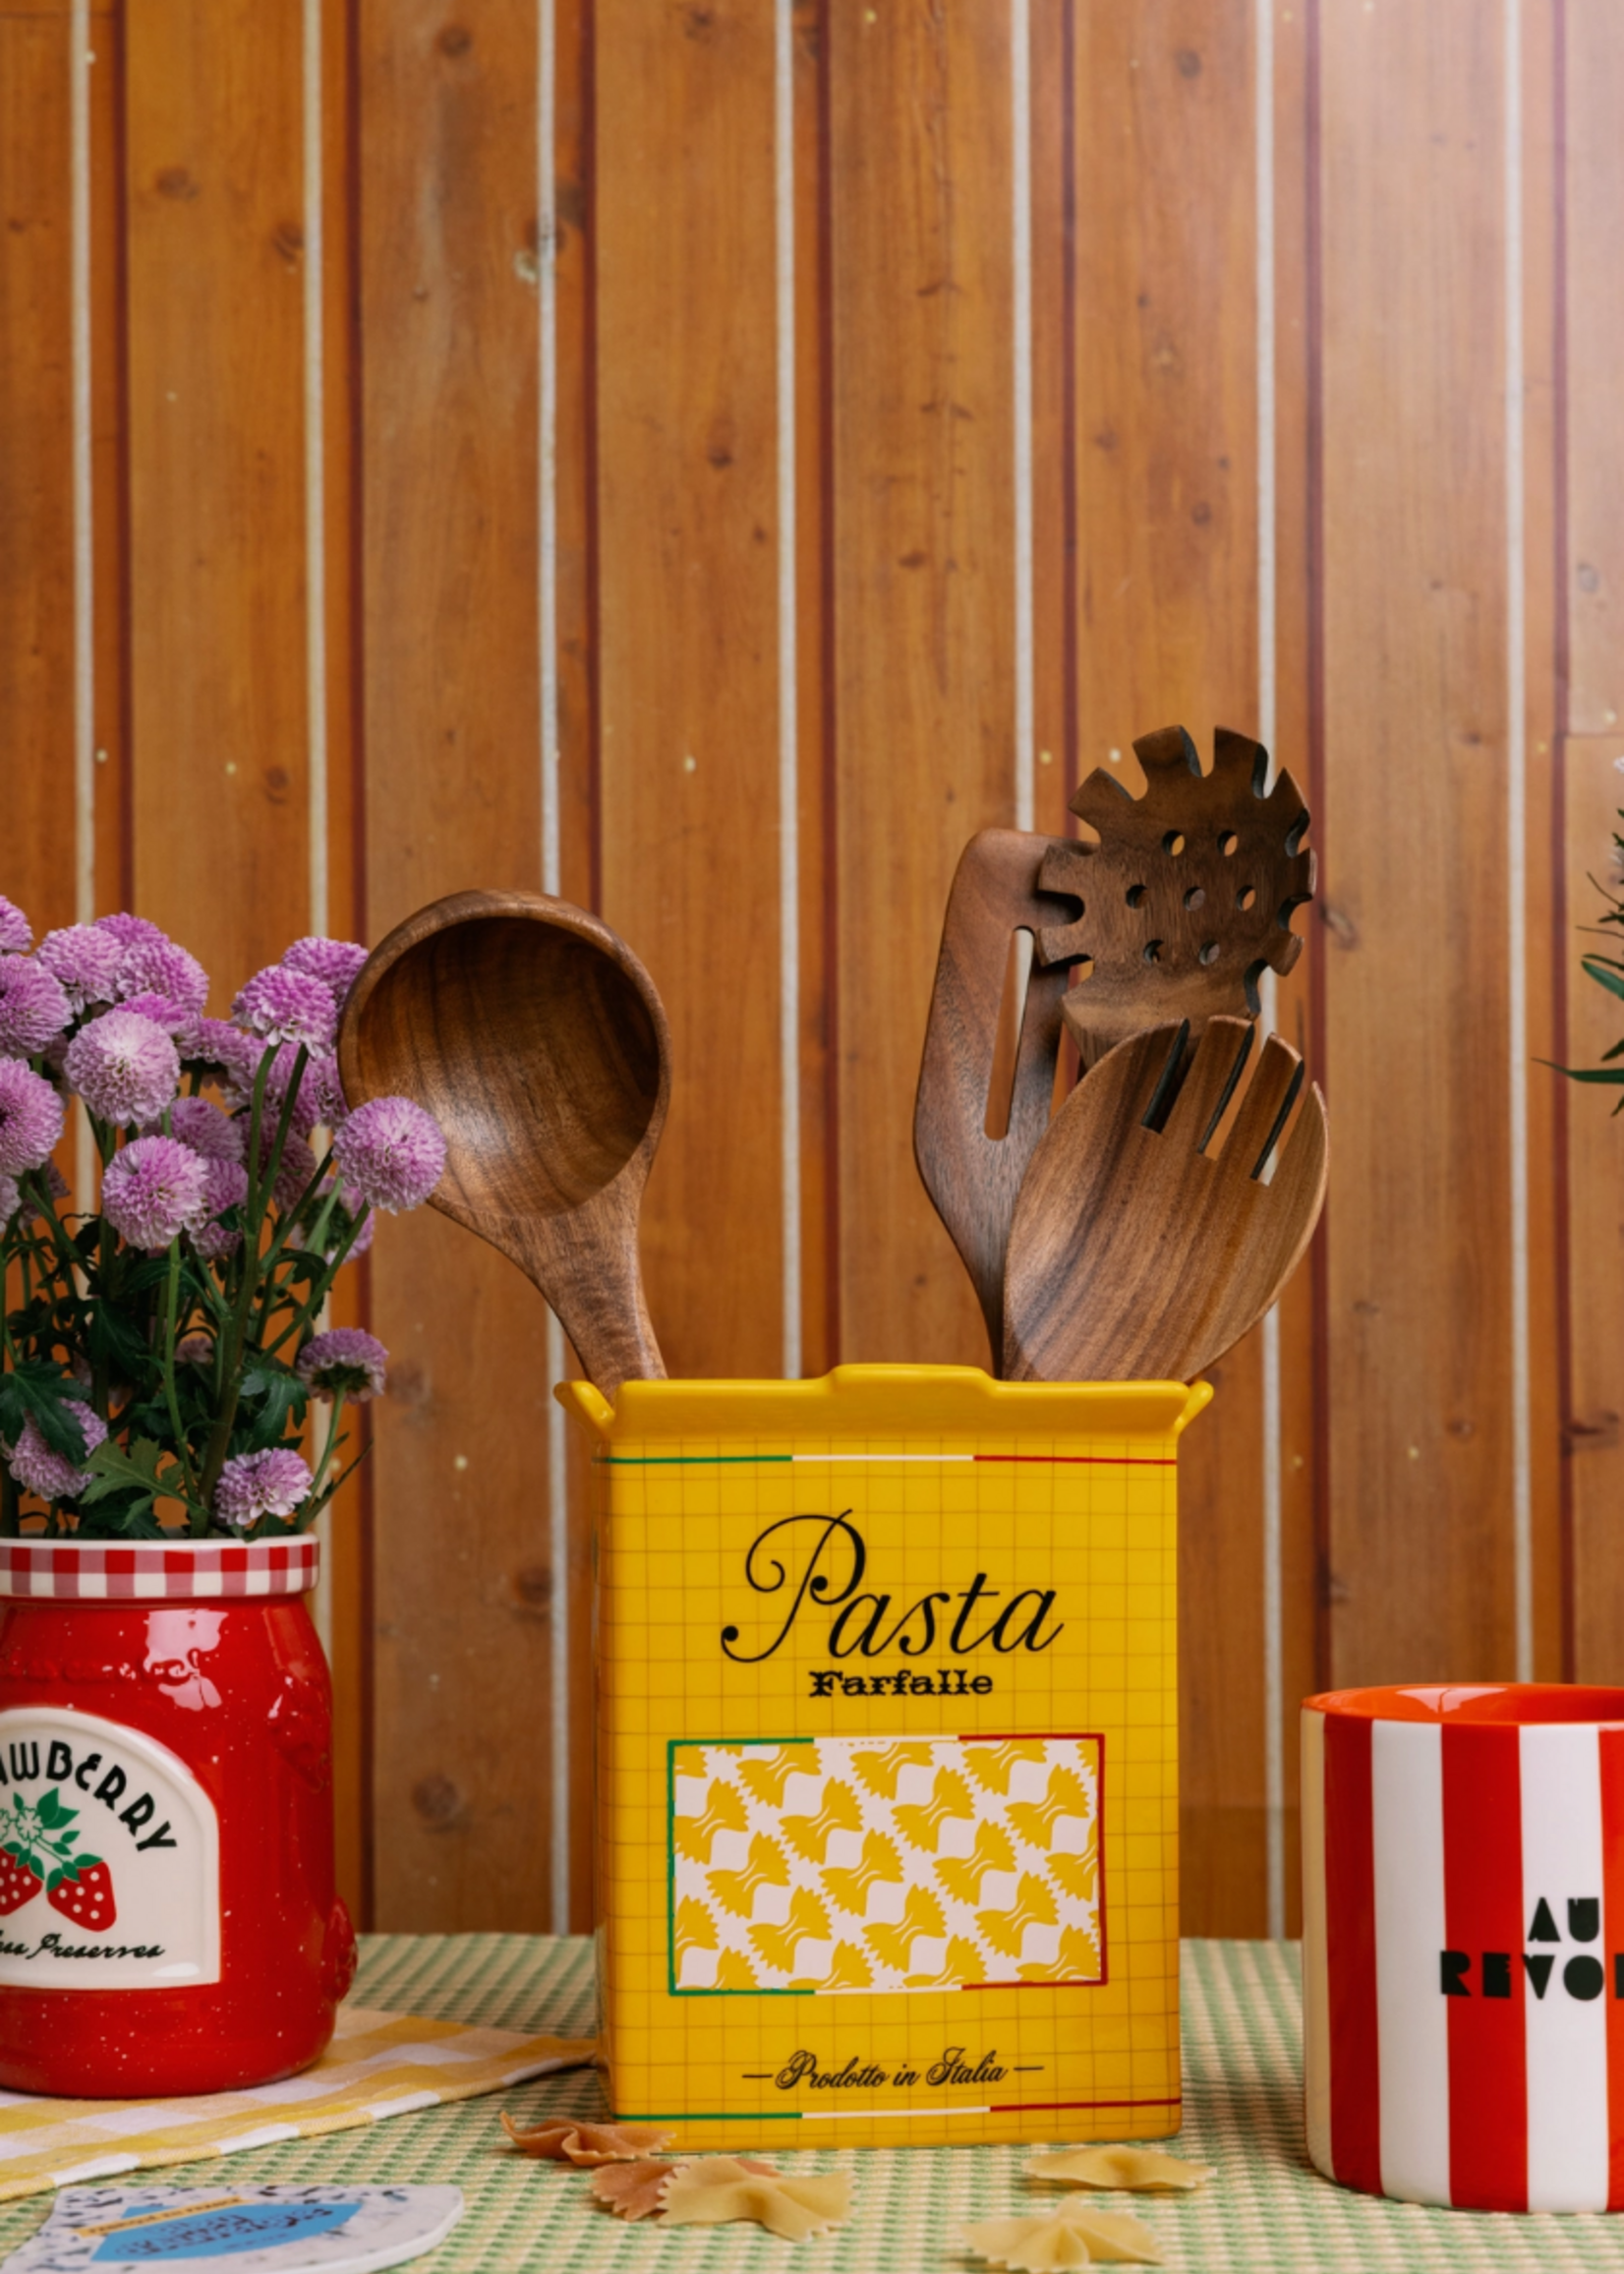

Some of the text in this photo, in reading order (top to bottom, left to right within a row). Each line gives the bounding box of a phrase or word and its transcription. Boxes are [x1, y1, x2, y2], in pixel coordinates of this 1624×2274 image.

[721, 1508, 1065, 1663] Pasta
[808, 1669, 993, 1697] Farfalle
[1527, 1896, 1600, 1943] AU
[25, 1933, 165, 1959] Preserves
[775, 2046, 1009, 2090] Prodotto in Italia
